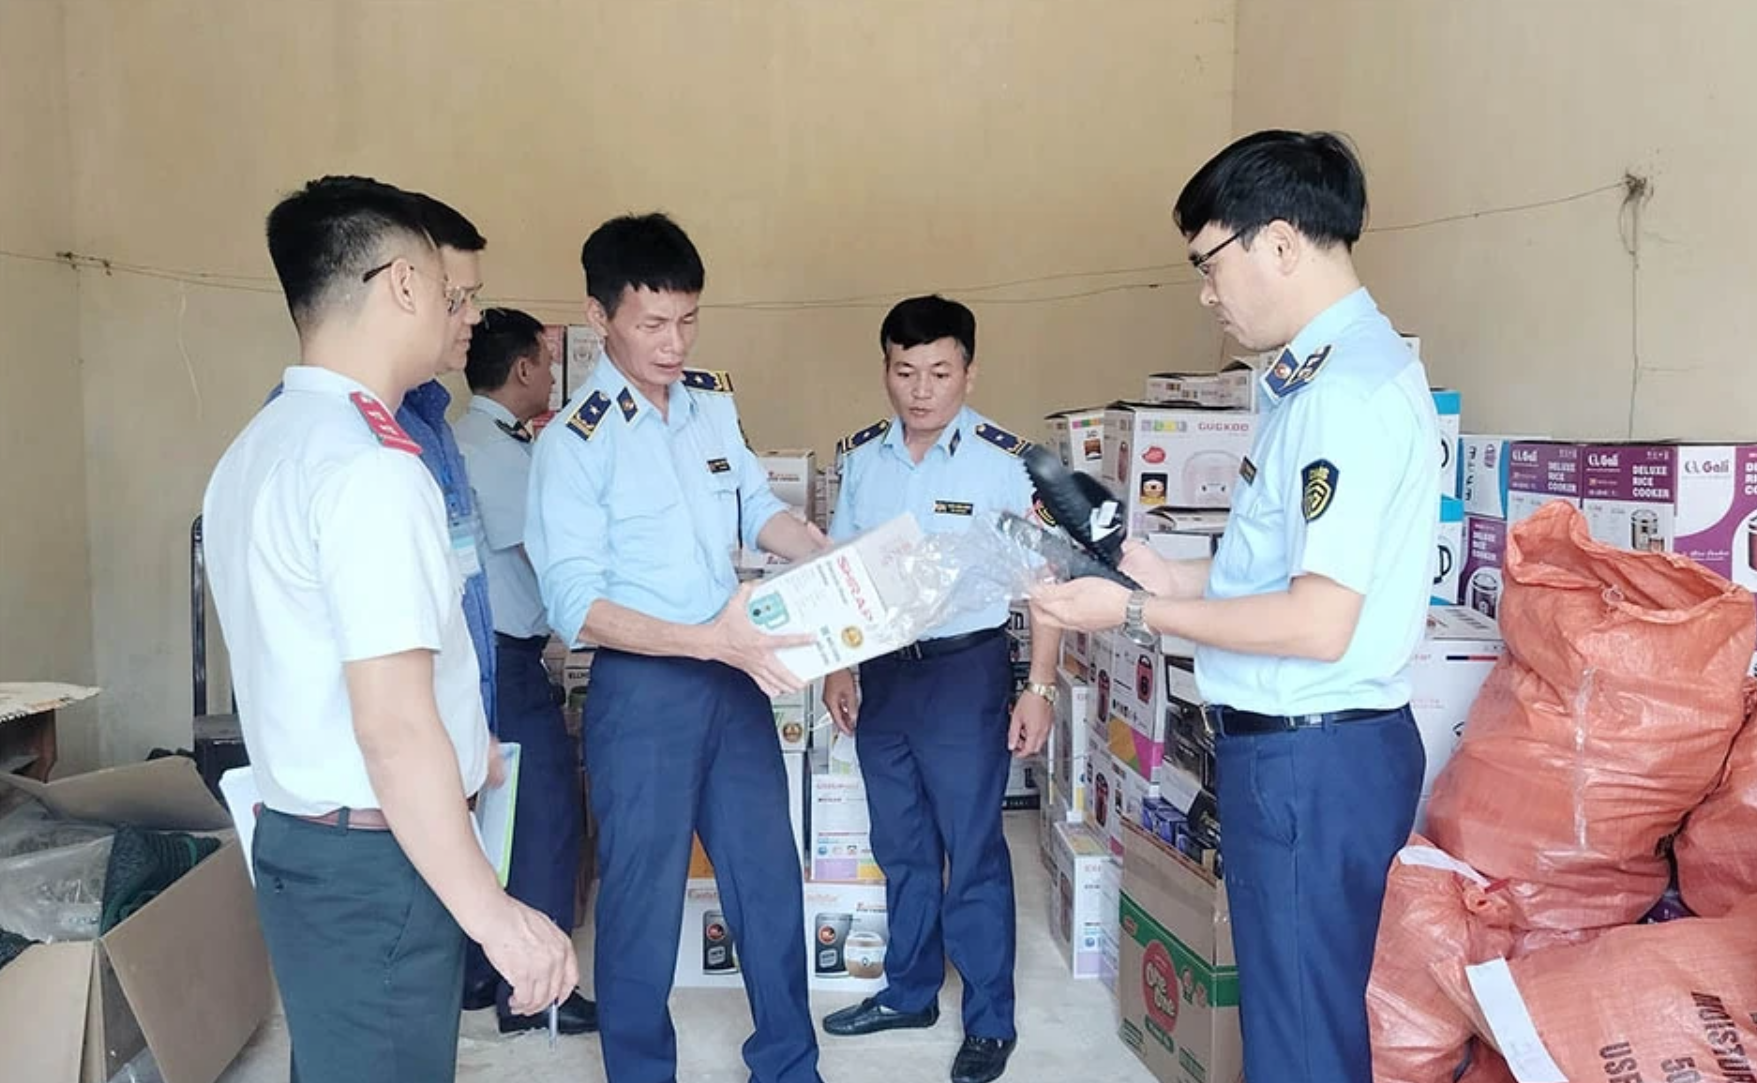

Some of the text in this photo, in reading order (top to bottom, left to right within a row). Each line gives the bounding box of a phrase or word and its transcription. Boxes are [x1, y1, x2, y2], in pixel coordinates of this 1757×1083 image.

[1632, 465, 1668, 476] DELUXE
[1632, 476, 1654, 487] RICE
[1632, 487, 1670, 499] COOKER
[1691, 991, 1757, 1083] MOISTUR
